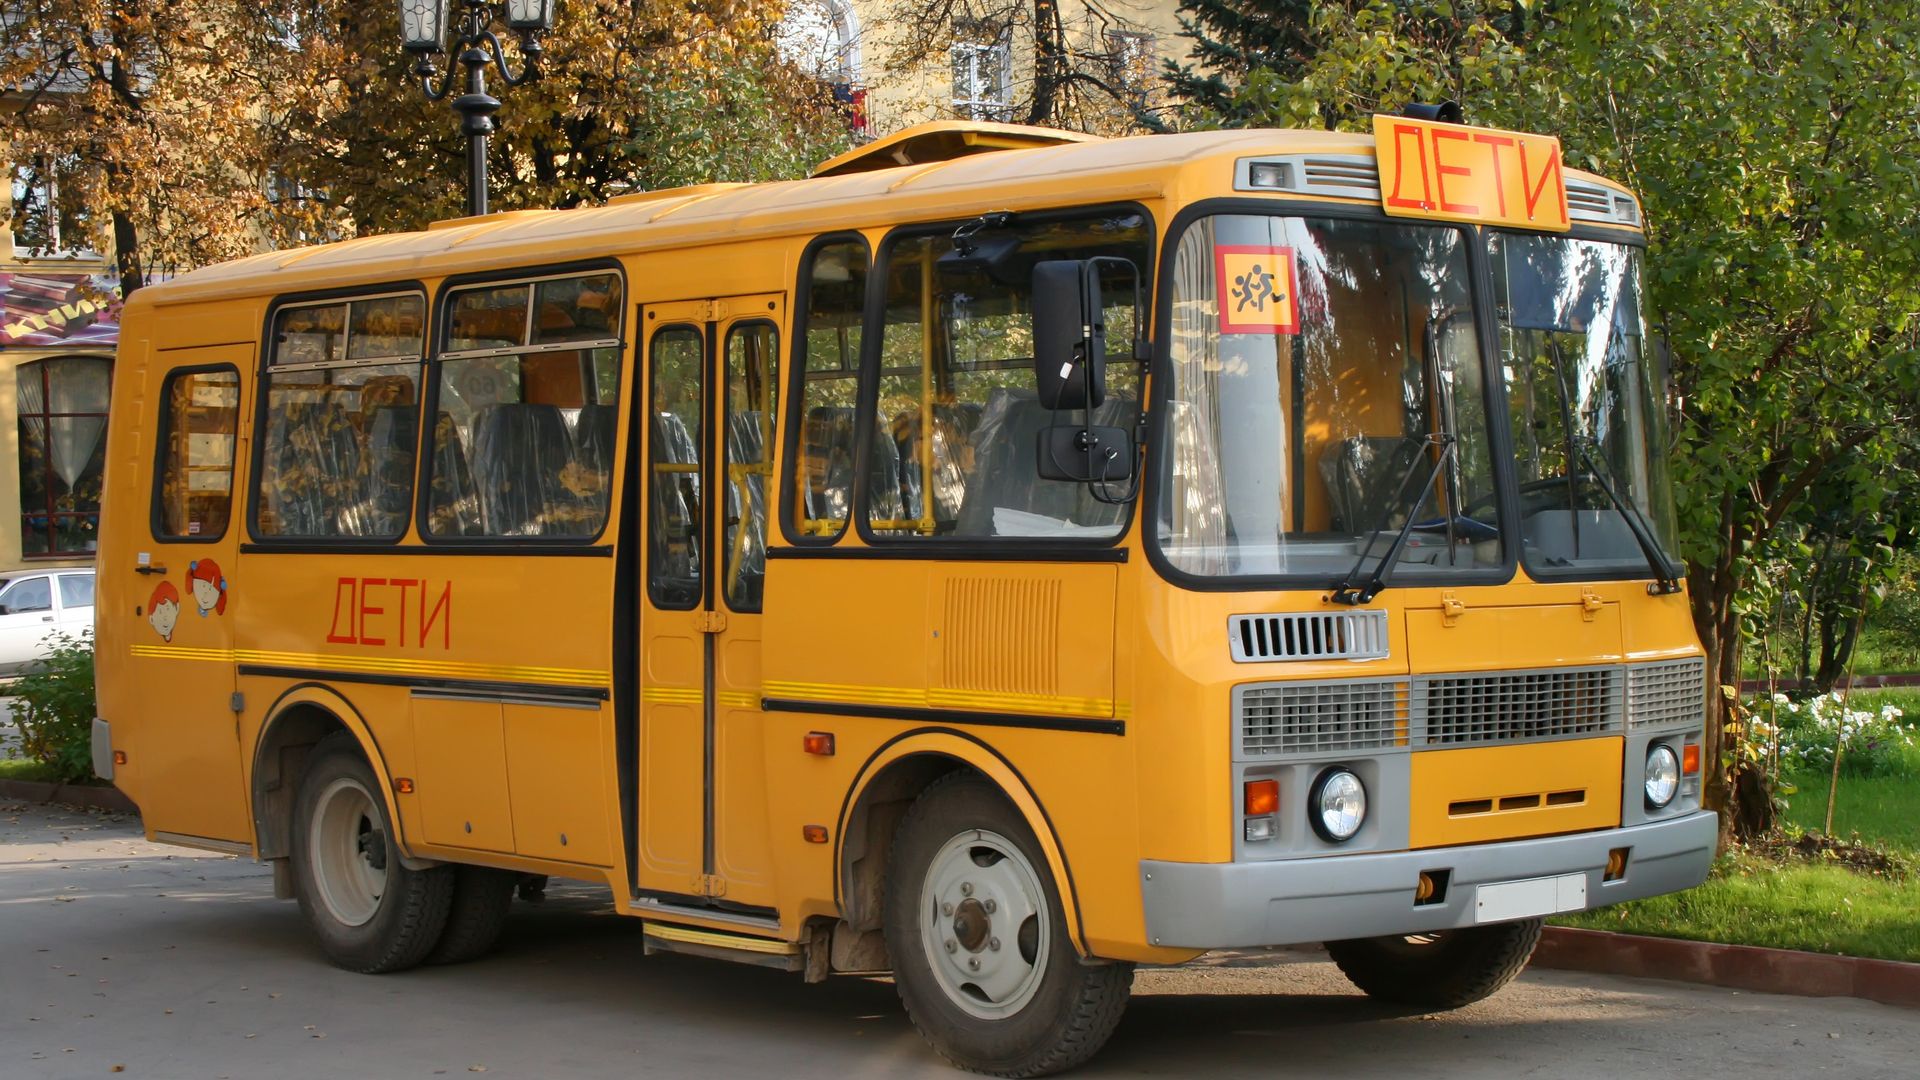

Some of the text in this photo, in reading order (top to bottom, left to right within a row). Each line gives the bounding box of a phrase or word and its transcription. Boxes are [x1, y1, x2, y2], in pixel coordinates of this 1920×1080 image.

[1387, 124, 1567, 225] ДЕТИ
[4, 287, 122, 338] КНИ
[326, 577, 452, 650] ДЕТИ
